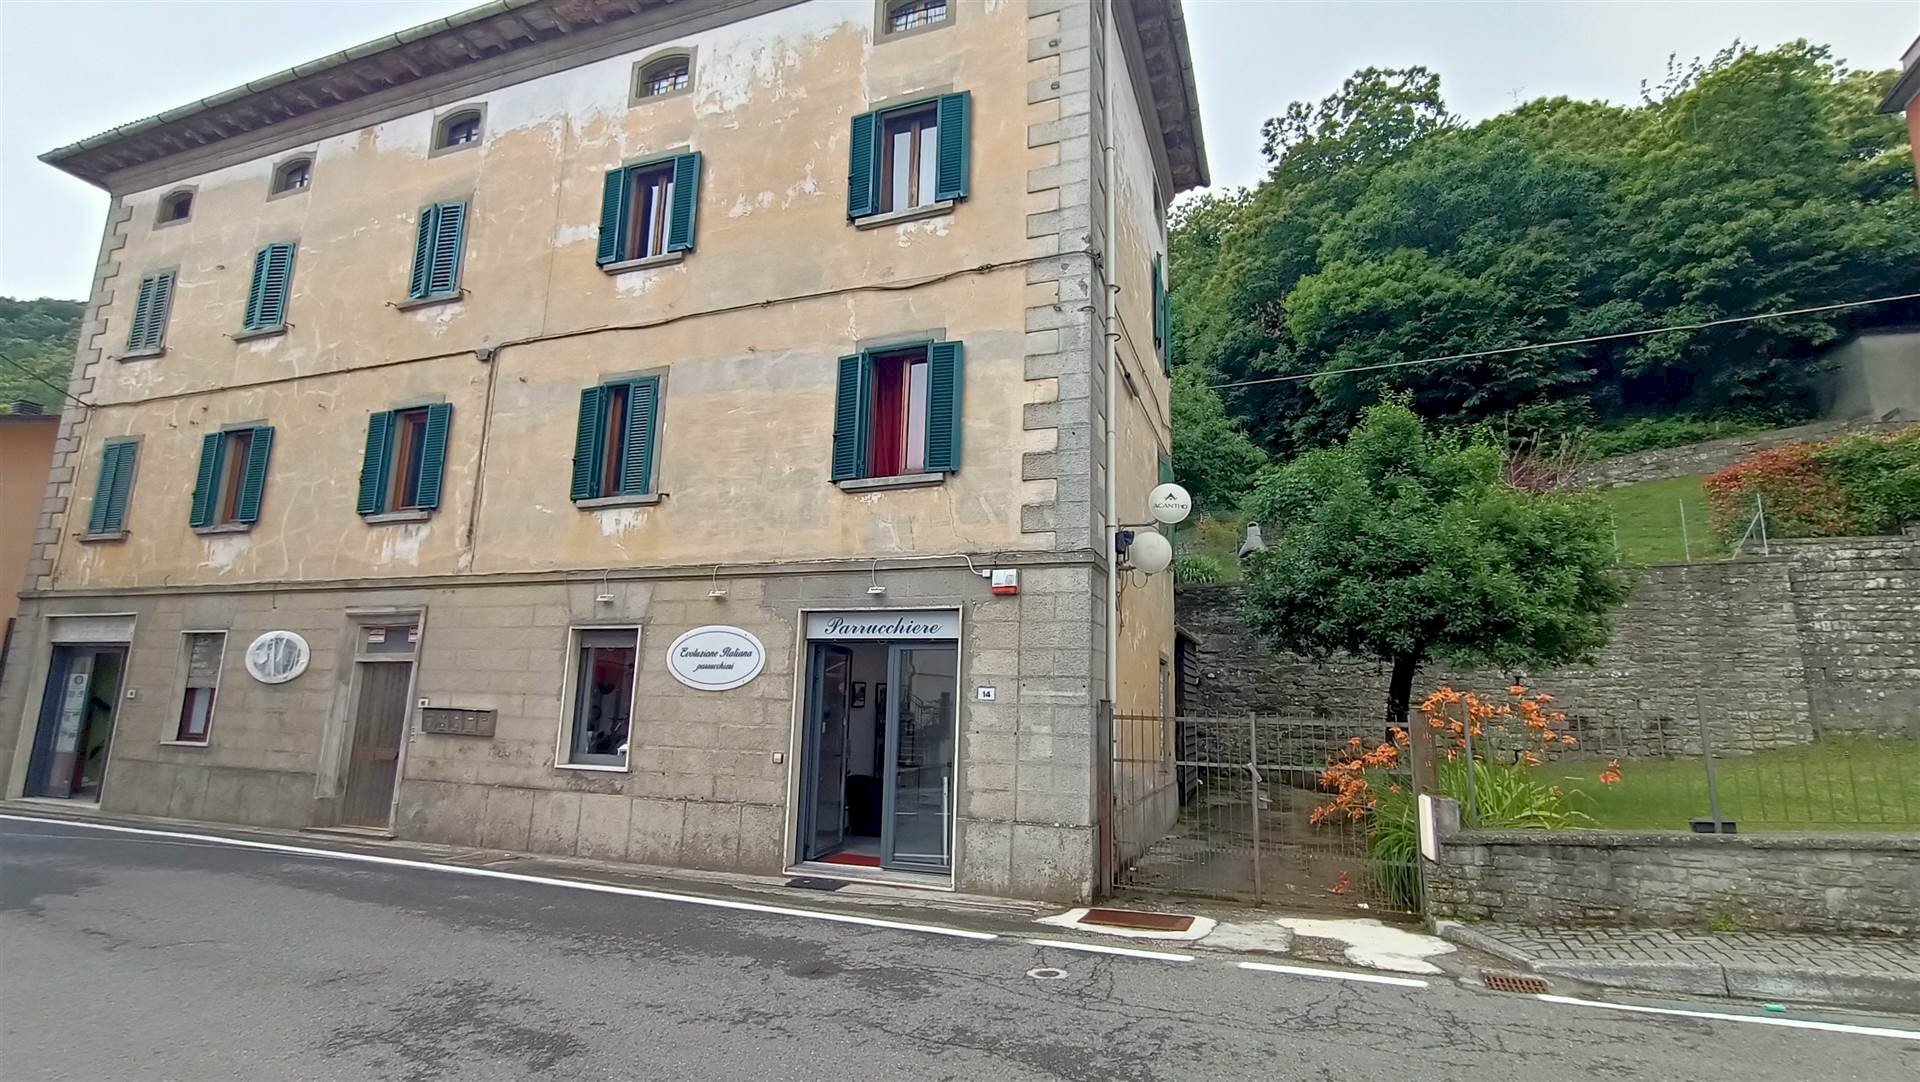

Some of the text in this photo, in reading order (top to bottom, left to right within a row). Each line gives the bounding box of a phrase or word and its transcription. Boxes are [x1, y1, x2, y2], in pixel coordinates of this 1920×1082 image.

[824, 616, 943, 634] Parrucchiere
[680, 646, 753, 658] Evoluzione Italiana
[982, 690, 991, 698] 14
